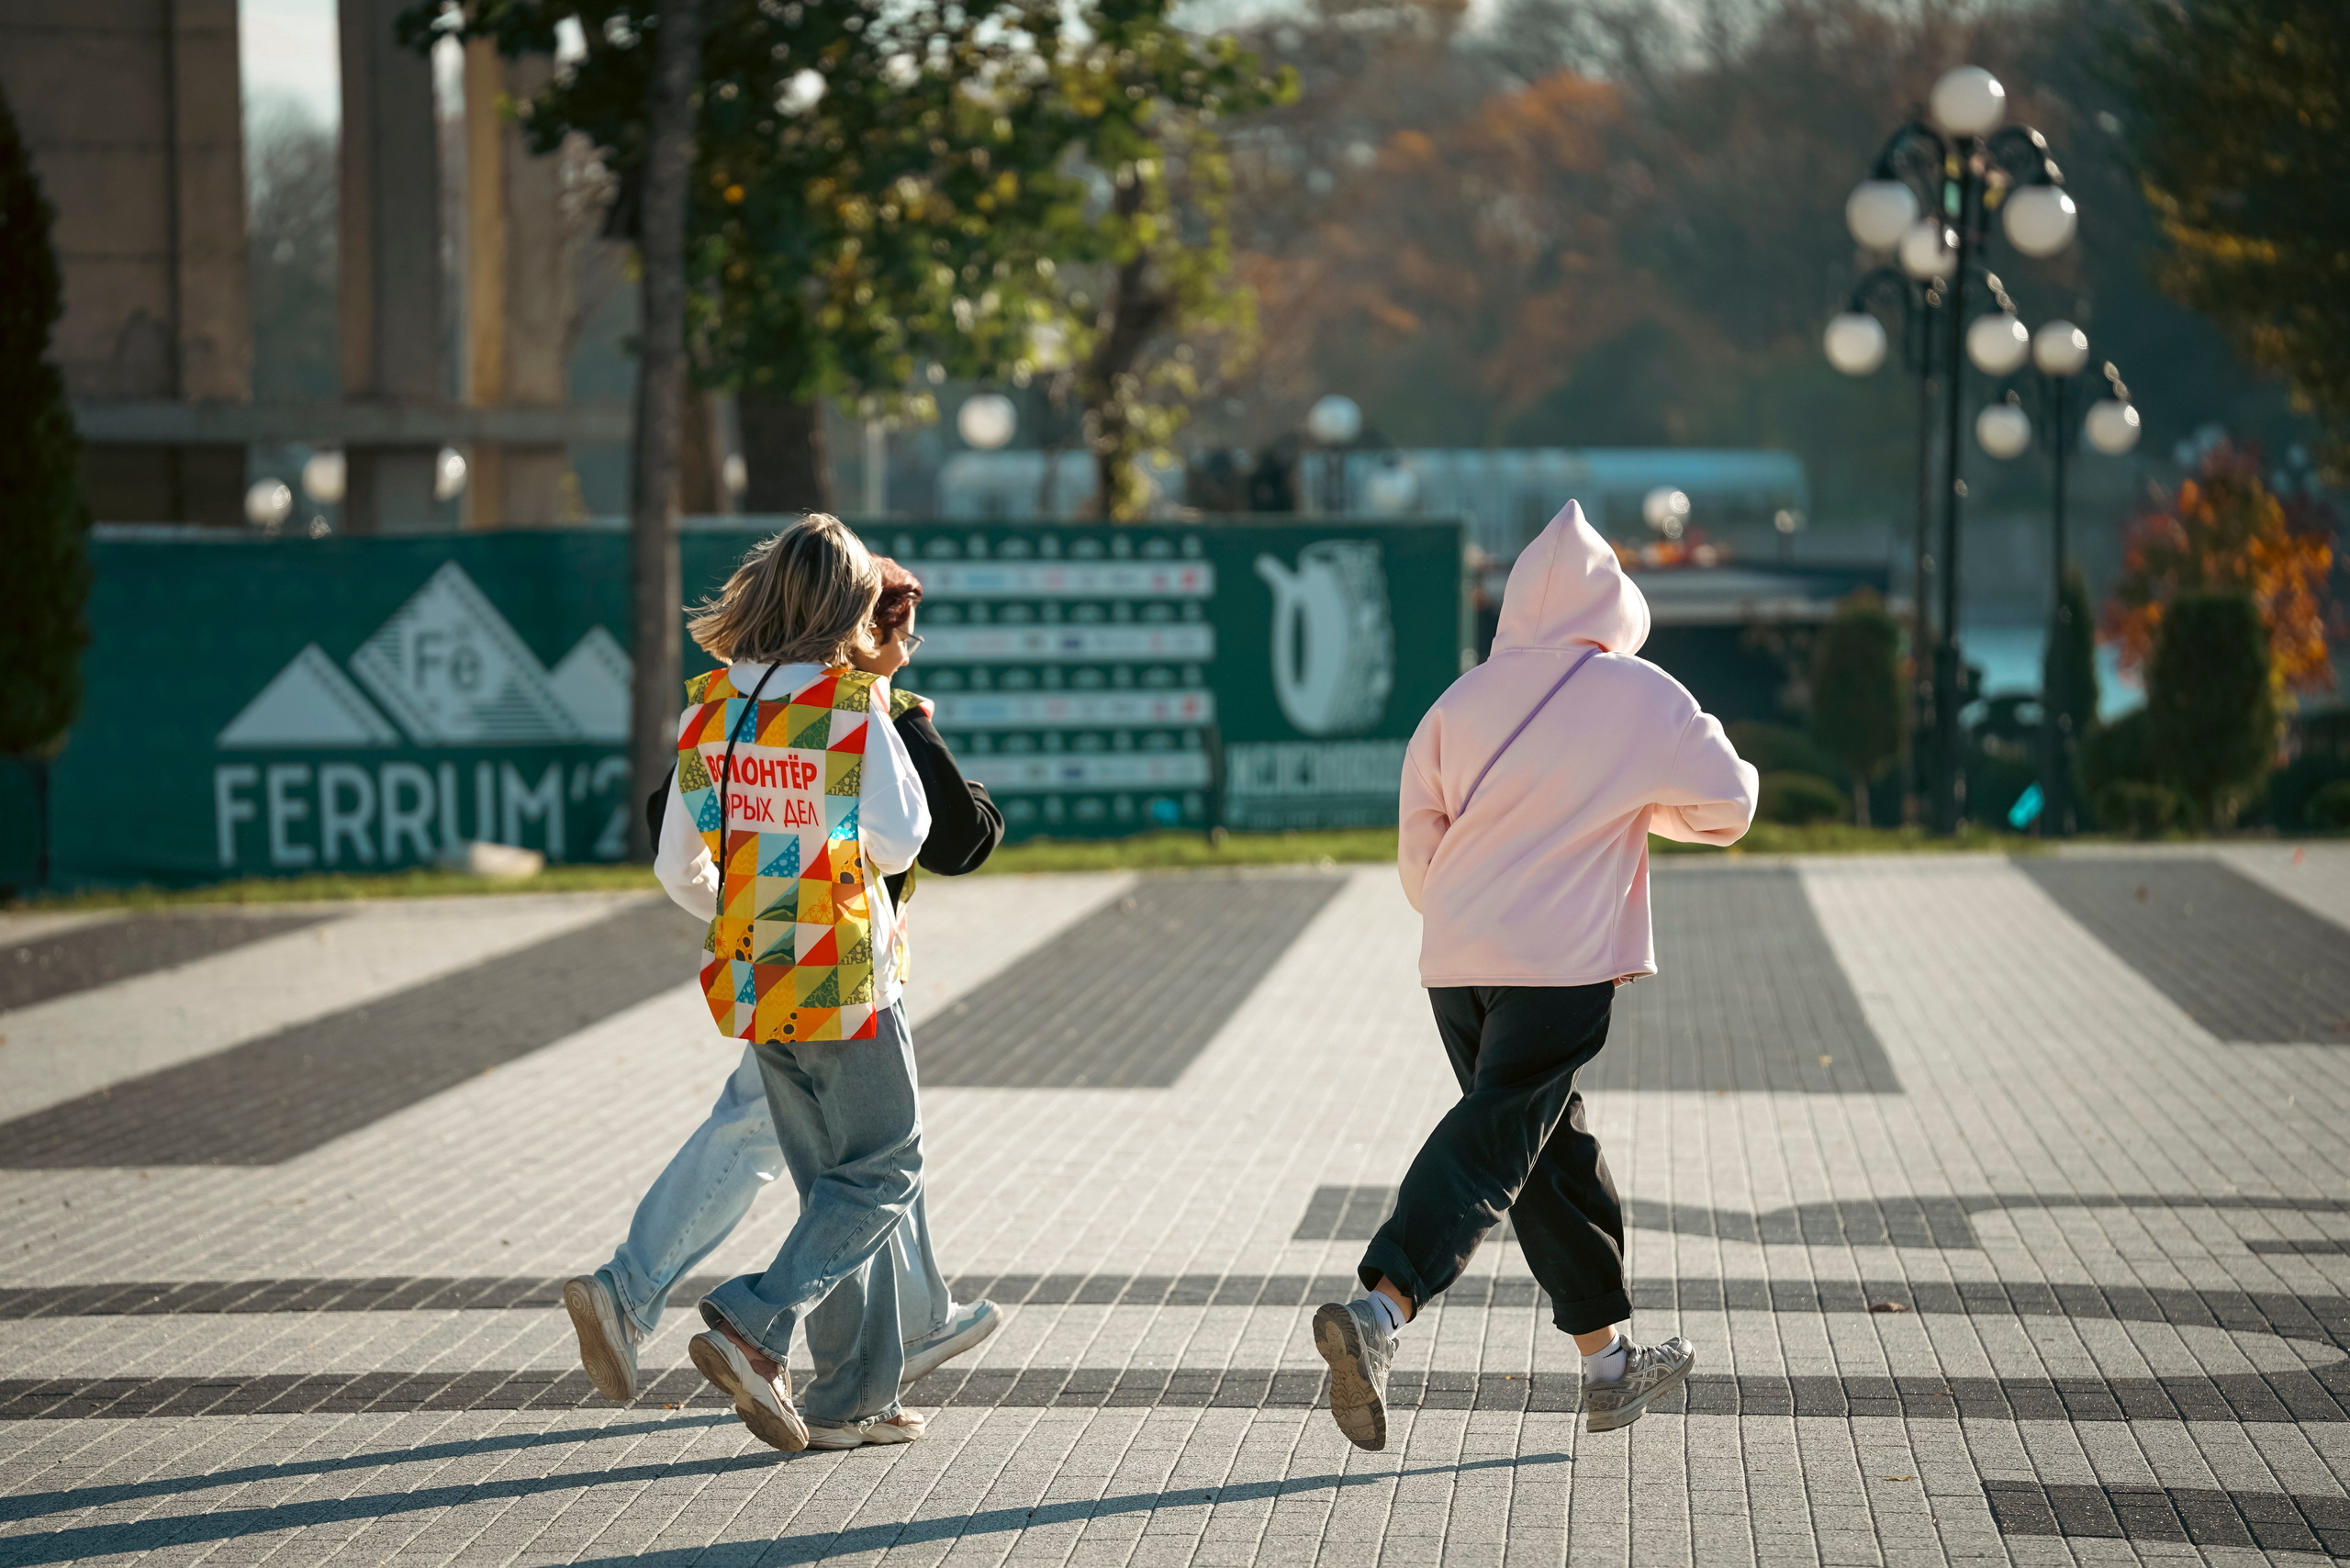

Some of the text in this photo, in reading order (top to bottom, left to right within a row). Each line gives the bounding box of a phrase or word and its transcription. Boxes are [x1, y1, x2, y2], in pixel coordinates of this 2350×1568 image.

[706, 754, 817, 790] ВОЛОНТЁР
[213, 756, 632, 866] FERRUM'2
[784, 799, 819, 828] ДЕЛ
